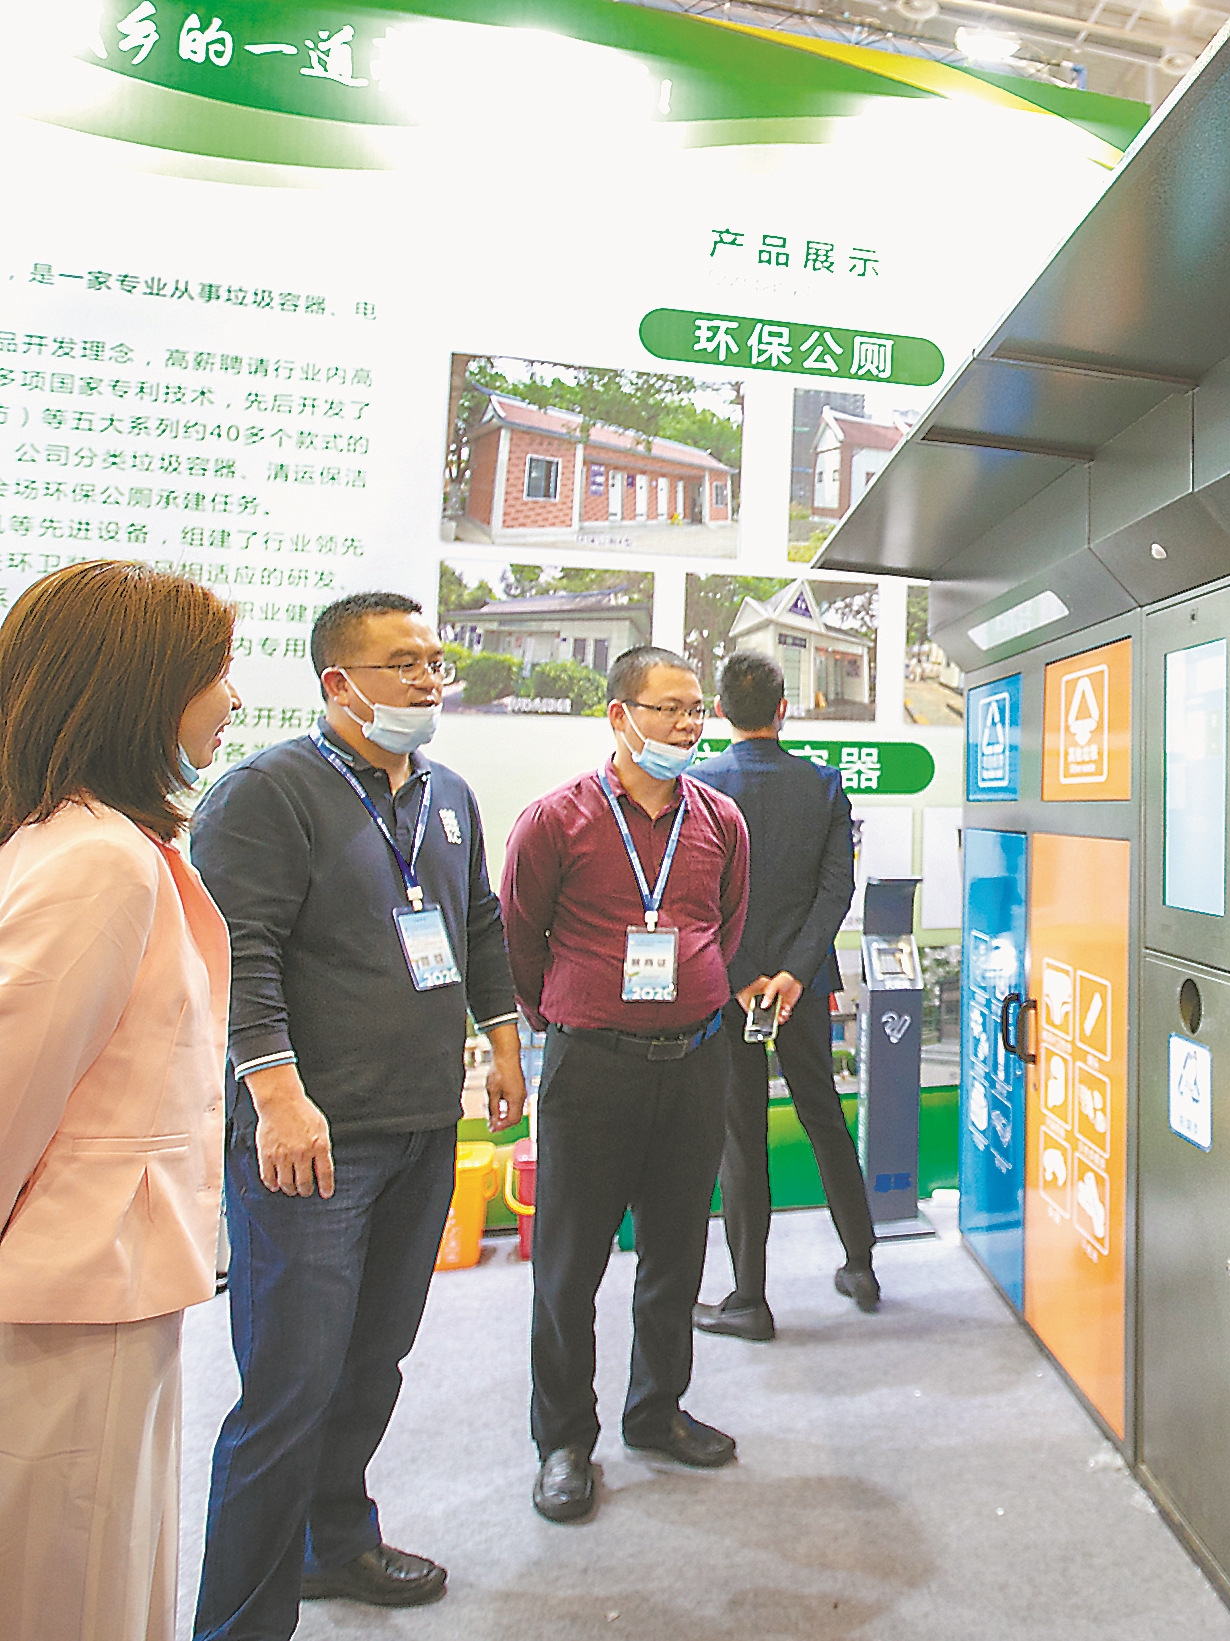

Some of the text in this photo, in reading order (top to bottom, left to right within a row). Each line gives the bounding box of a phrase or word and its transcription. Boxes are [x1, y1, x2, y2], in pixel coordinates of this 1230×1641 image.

[98, 0, 402, 90] 乡的一道
[709, 228, 880, 277] 产品展示
[693, 319, 895, 379] 环保公厕
[0, 513, 366, 558] 等先进设备，组建了行业领先
